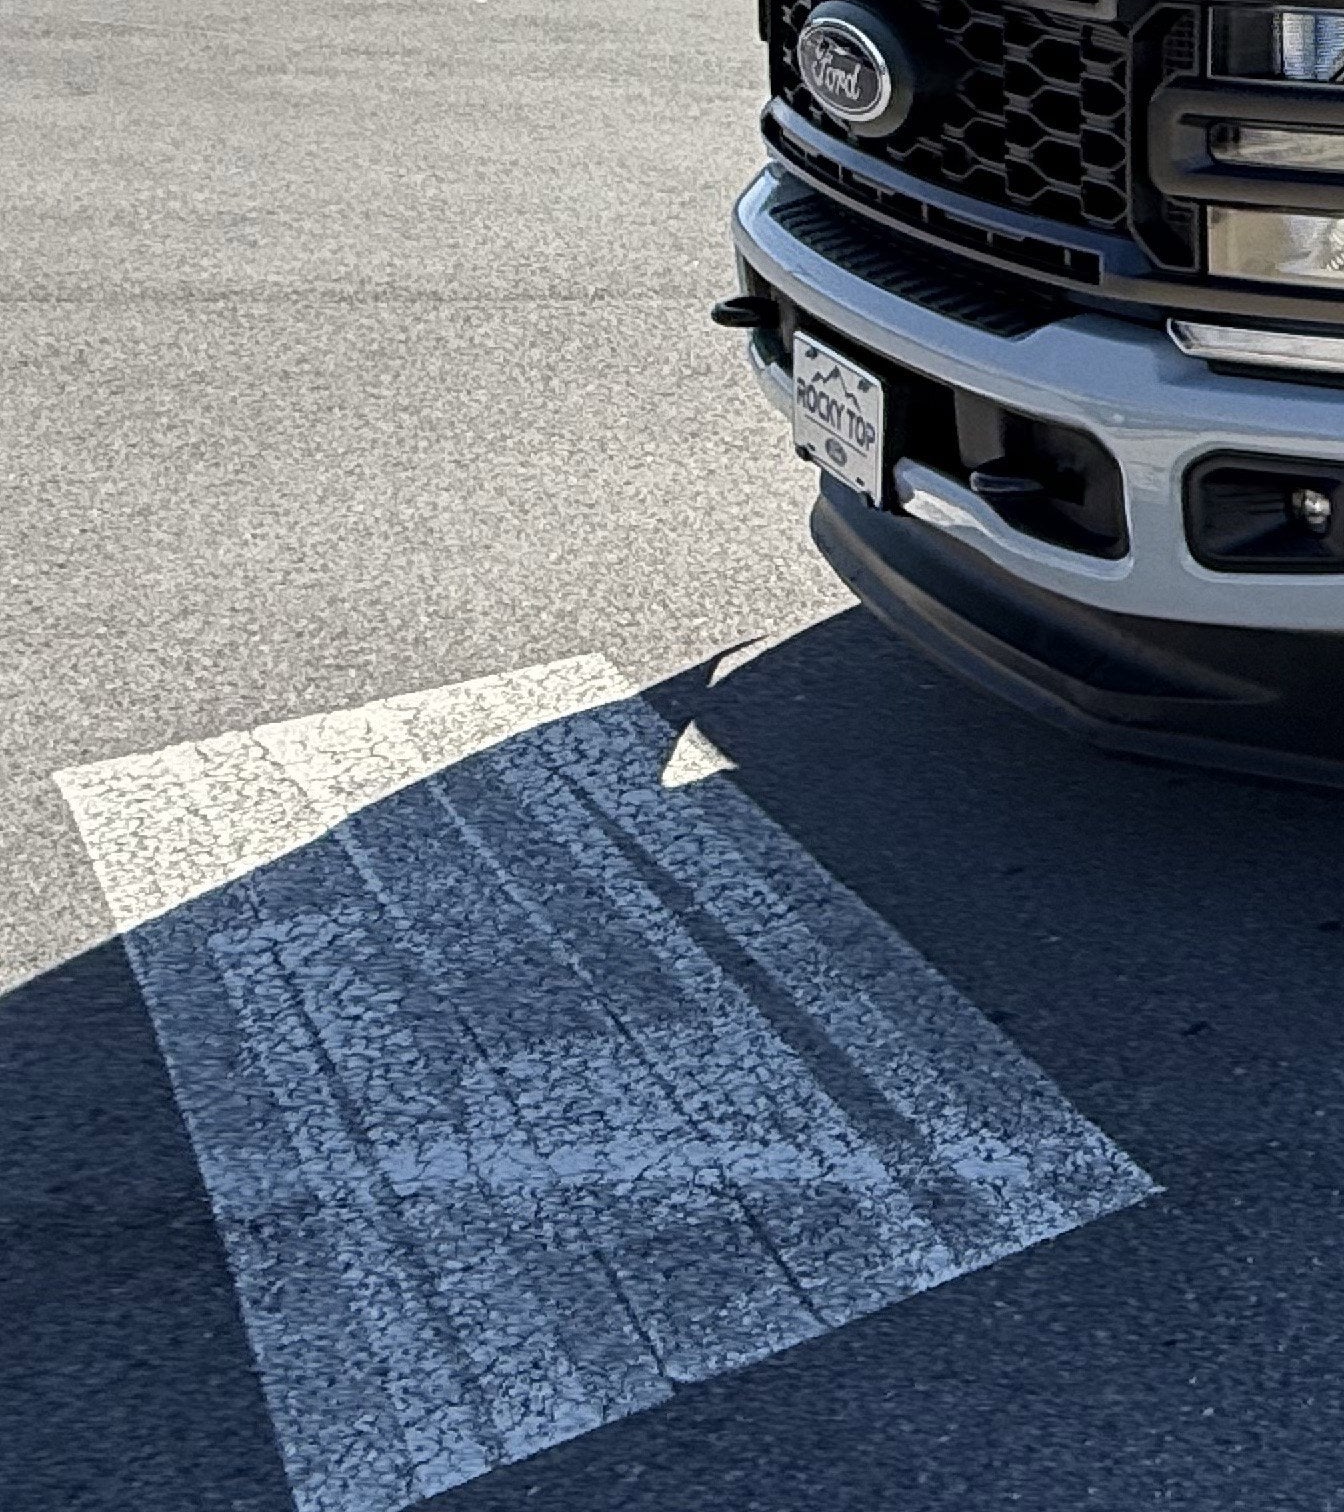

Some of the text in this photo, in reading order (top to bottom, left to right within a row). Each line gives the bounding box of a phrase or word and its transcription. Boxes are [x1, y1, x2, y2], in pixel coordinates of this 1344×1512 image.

[811, 34, 862, 100] Ford
[797, 383, 876, 451] ROCKY TOP
